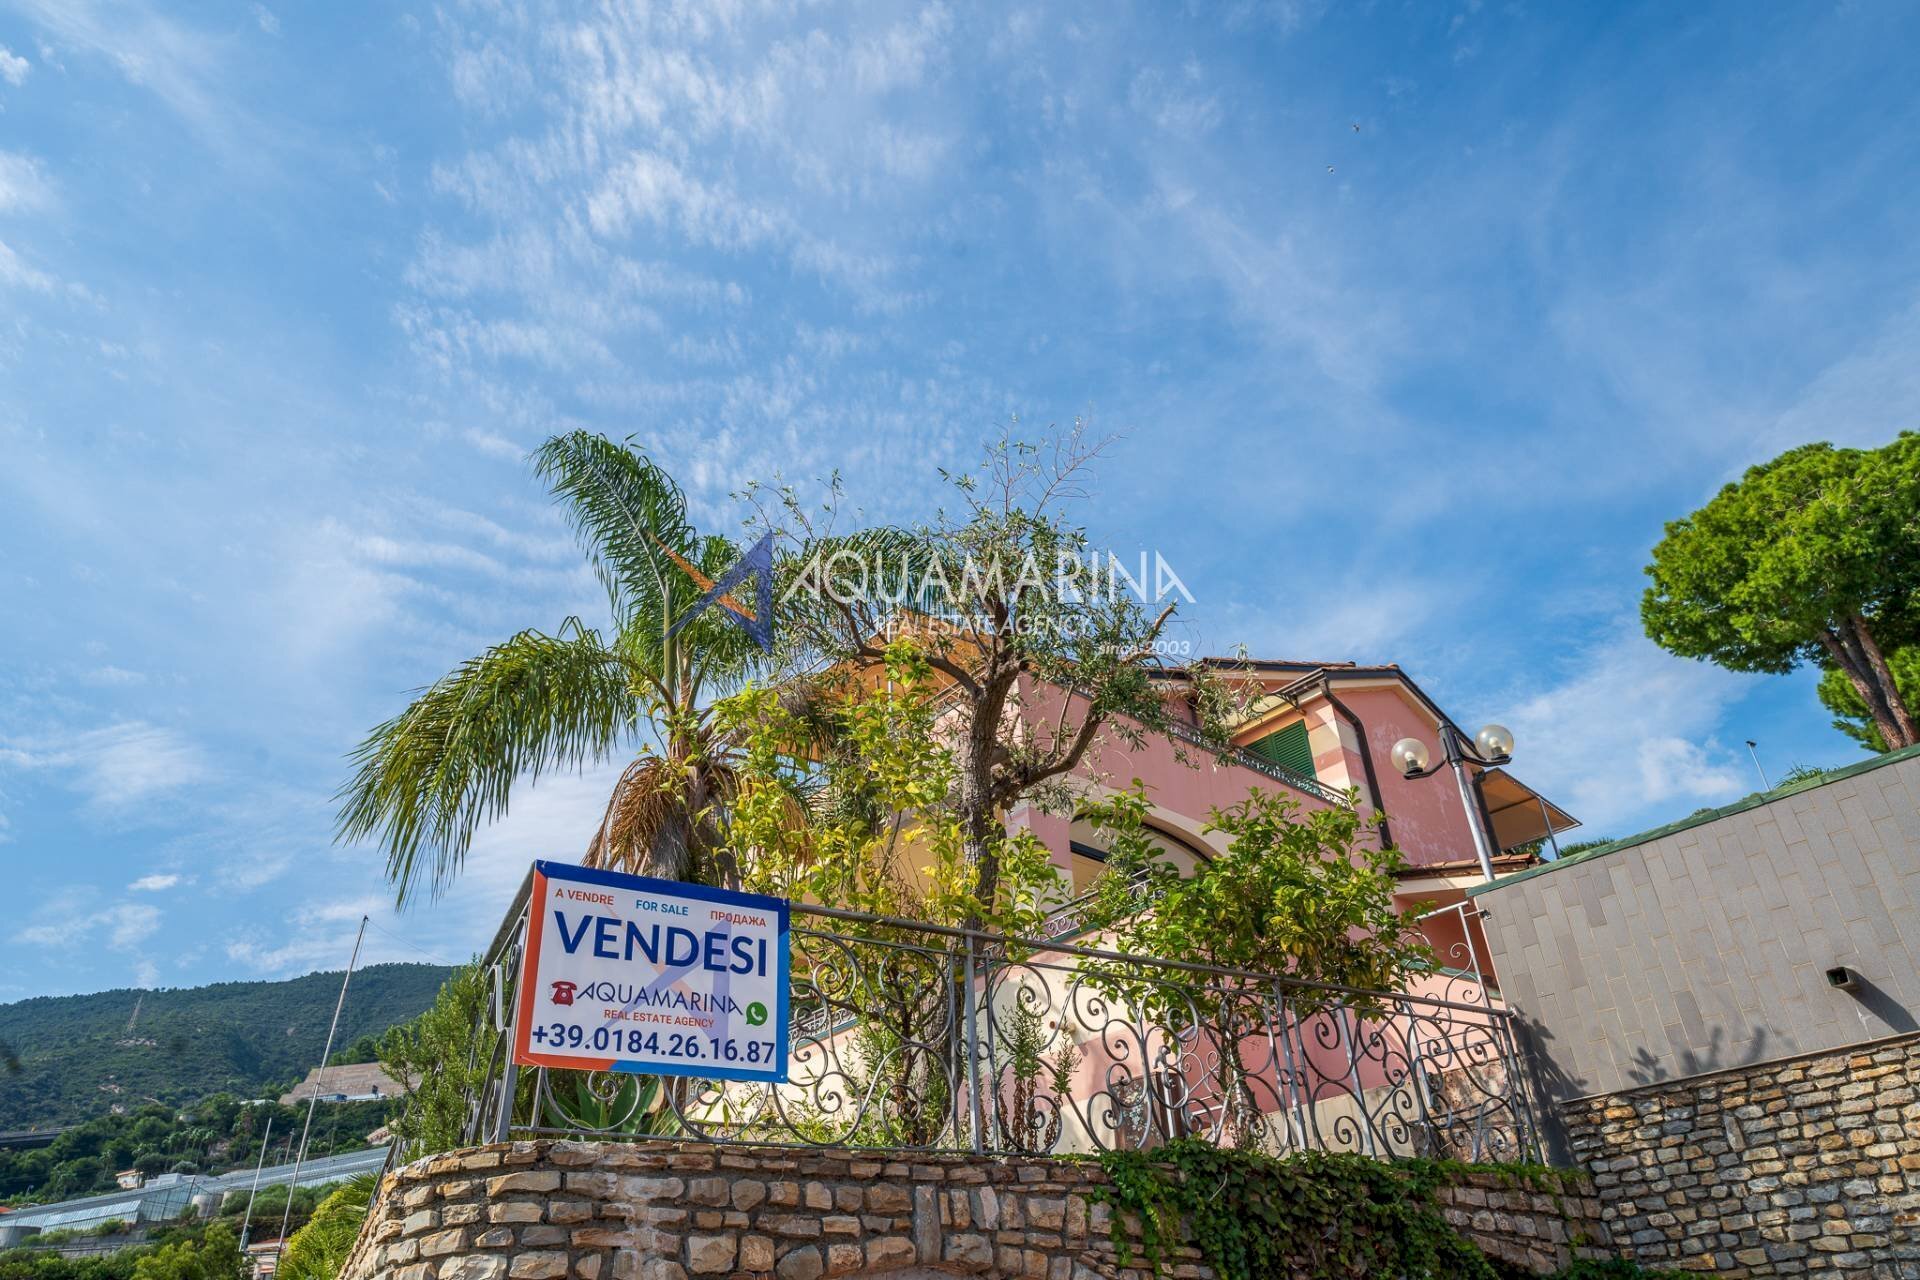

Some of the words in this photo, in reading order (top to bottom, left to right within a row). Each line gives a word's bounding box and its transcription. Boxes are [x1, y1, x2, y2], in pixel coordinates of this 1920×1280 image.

[555, 887, 564, 899] A
[567, 889, 615, 906] VENDRE
[635, 899, 658, 912] FOR
[660, 903, 689, 916] SALE
[710, 910, 767, 928] ПРОДАЖА
[554, 910, 767, 977] VENDESI
[576, 981, 744, 1016] AQUAMARINA
[604, 1009, 630, 1021] REAL
[632, 1012, 672, 1025] ESTATE
[674, 1016, 715, 1029] AGENCY
[532, 1022, 776, 1064] +39.0184.26.16.87
